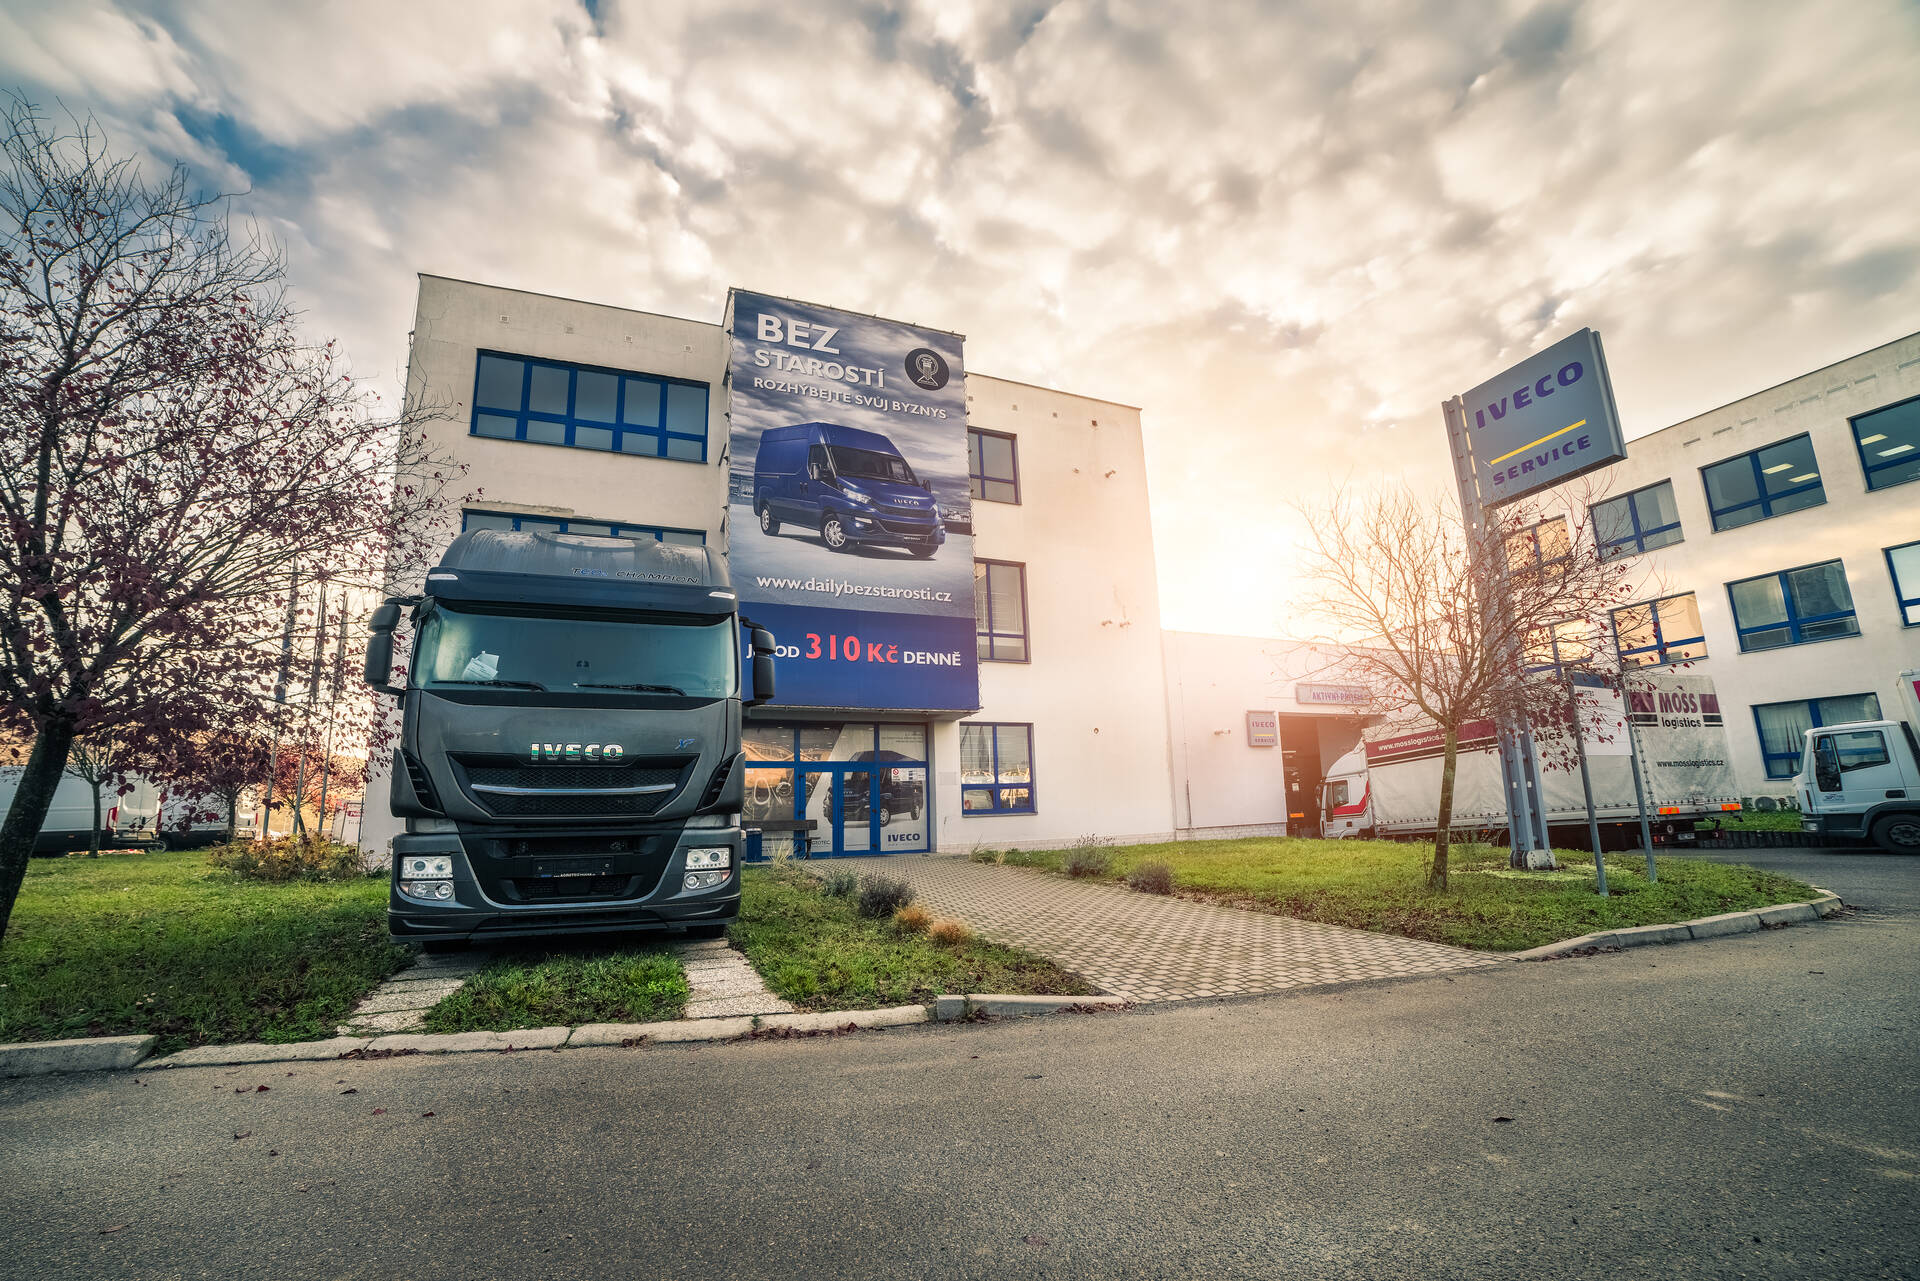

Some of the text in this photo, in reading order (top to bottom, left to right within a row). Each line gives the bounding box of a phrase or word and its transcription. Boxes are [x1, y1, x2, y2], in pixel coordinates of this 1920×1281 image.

[757, 313, 840, 355] BEZ
[754, 349, 885, 388] STAROSTÍ
[753, 377, 948, 419] ROZHÝBEJTE SVŮJ BYZNYS
[1475, 361, 1584, 429] IVECO
[1493, 435, 1592, 486] SERVICE
[616, 569, 698, 584] CHAMPION
[757, 576, 952, 602] www.dailybezstarosti.cz
[775, 645, 800, 658] OD
[805, 633, 861, 662] 310
[867, 642, 899, 664] Kč
[903, 650, 962, 667] DENNĚ
[1659, 692, 1699, 714] MOSS
[1252, 720, 1275, 728] IVECO
[1662, 716, 1702, 729] logistics
[530, 743, 624, 761] IVECO
[1378, 733, 1448, 751] www.mosslogistics.c
[887, 833, 921, 842] IVECO
